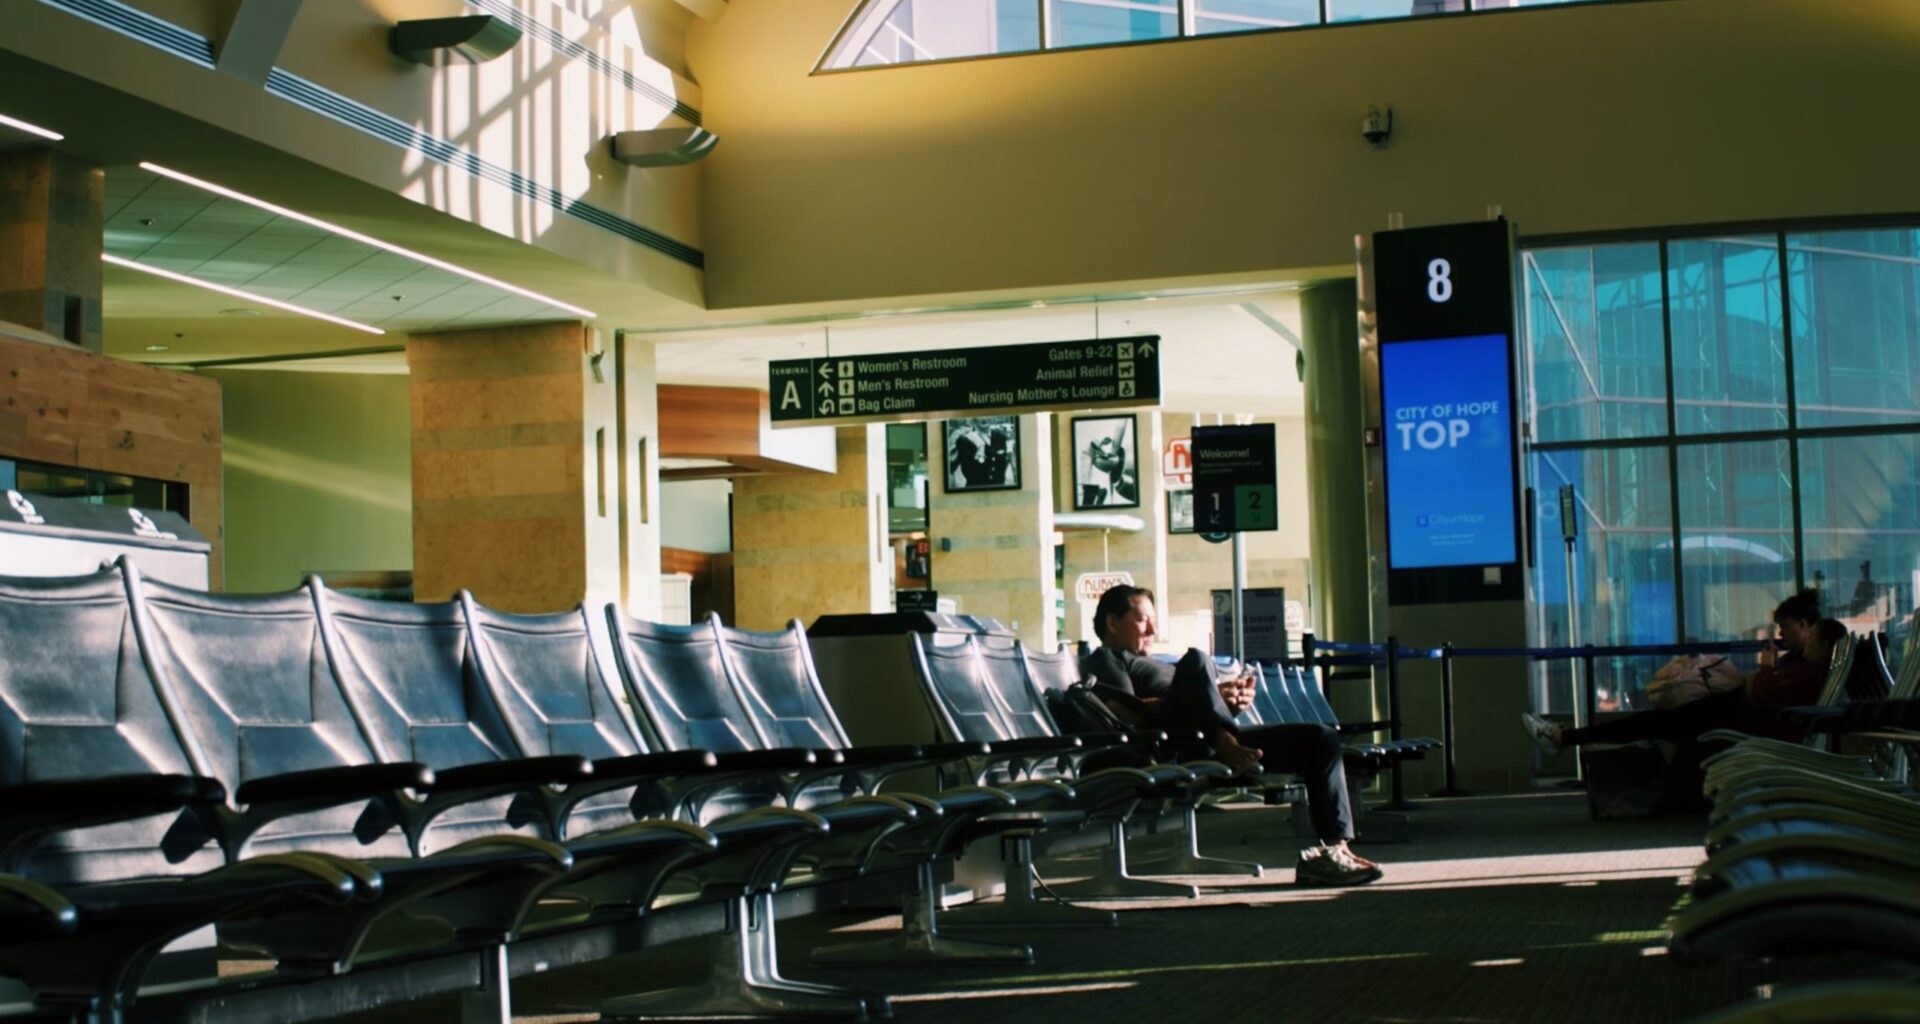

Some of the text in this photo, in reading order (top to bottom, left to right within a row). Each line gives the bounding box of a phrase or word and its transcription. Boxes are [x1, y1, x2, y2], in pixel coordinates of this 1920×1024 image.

[1428, 258, 1452, 302] 8
[1049, 346, 1114, 361] Gates 9-22
[771, 367, 810, 376] TERMINAL
[858, 357, 967, 373] Women's Restroom
[1036, 365, 1114, 381] Animal Relief
[858, 377, 949, 392] Men's Restroom
[780, 380, 801, 410] A
[969, 385, 1115, 404] Nursing Mother's Lounge
[858, 397, 915, 412] Bag Claim
[1396, 401, 1499, 420] CITY OF HOPE
[1396, 419, 1470, 451] TOP
[1200, 447, 1250, 460] Welcome!
[1211, 493, 1220, 511] 1
[1248, 491, 1262, 509] 2
